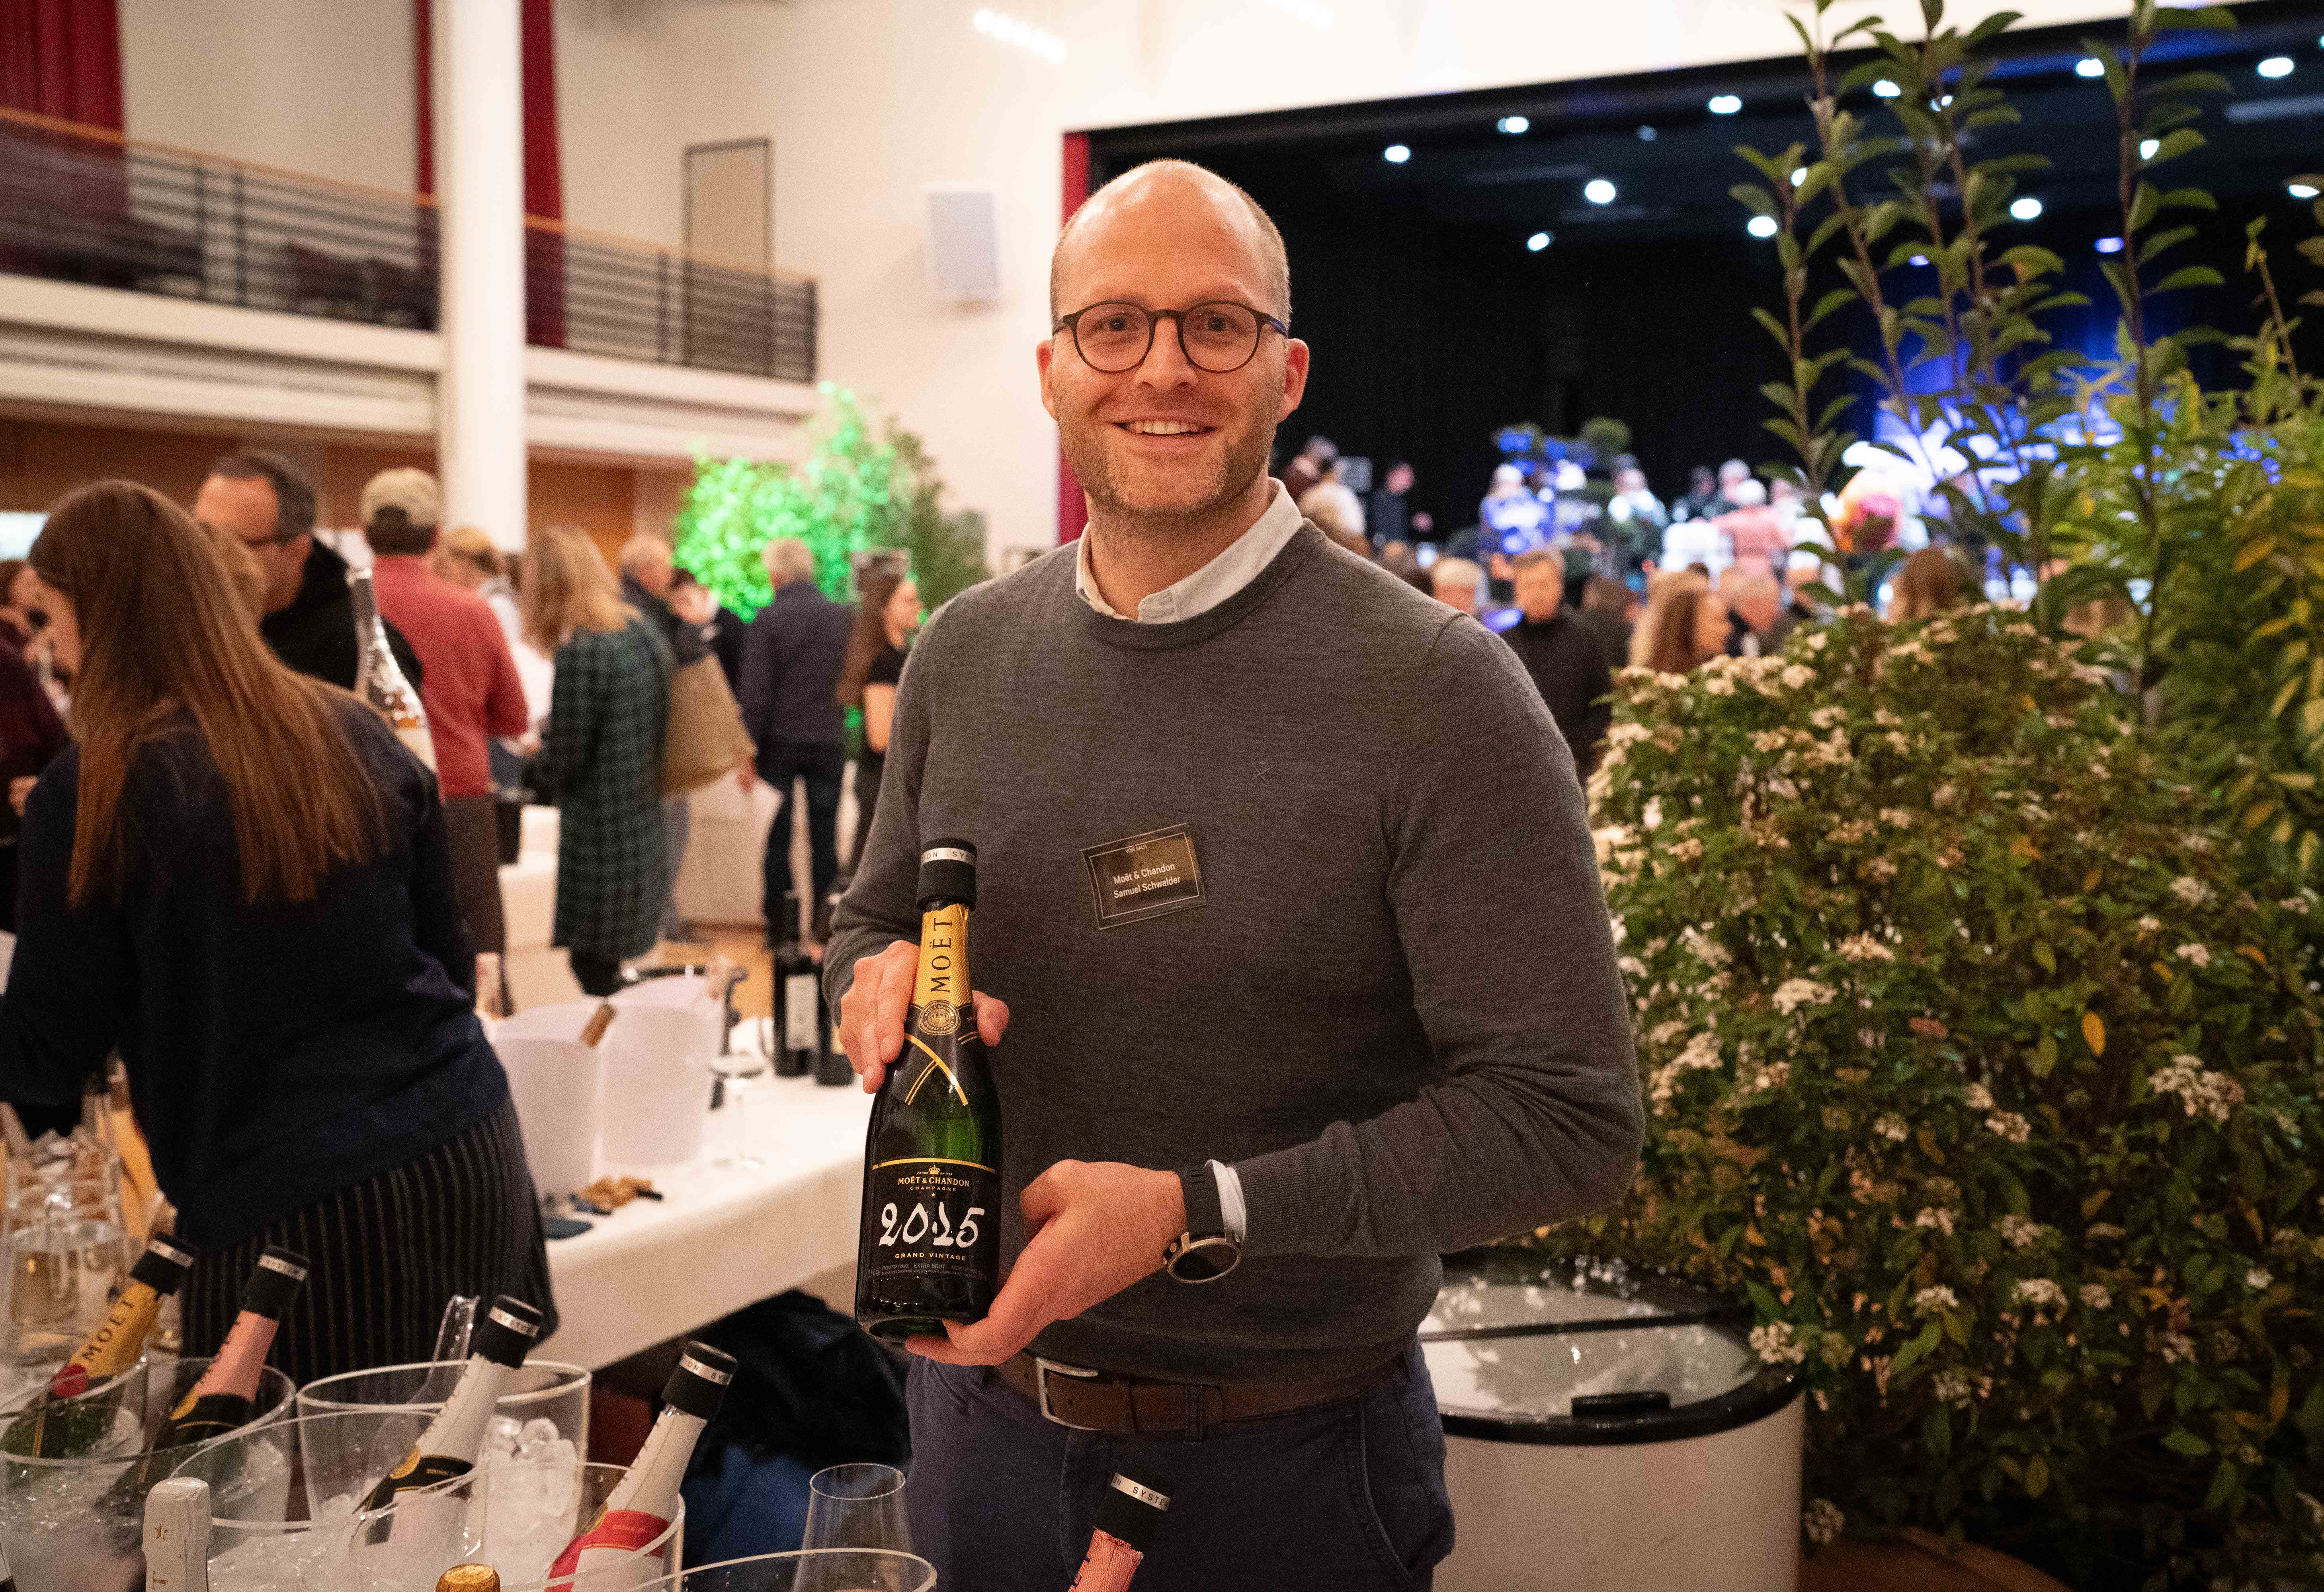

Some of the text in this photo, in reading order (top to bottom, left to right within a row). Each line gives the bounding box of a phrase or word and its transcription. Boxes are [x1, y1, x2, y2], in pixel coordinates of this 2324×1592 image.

[1134, 871, 1140, 879] &
[1141, 863, 1175, 878] Chandon
[1113, 876, 1181, 898] Samuel Schwalder
[929, 917, 953, 993] MOËT
[898, 1176, 921, 1185] MOËT
[929, 1176, 969, 1187] CHANDON
[878, 1202, 985, 1248] 2015
[929, 1253, 966, 1261] VINTAGE
